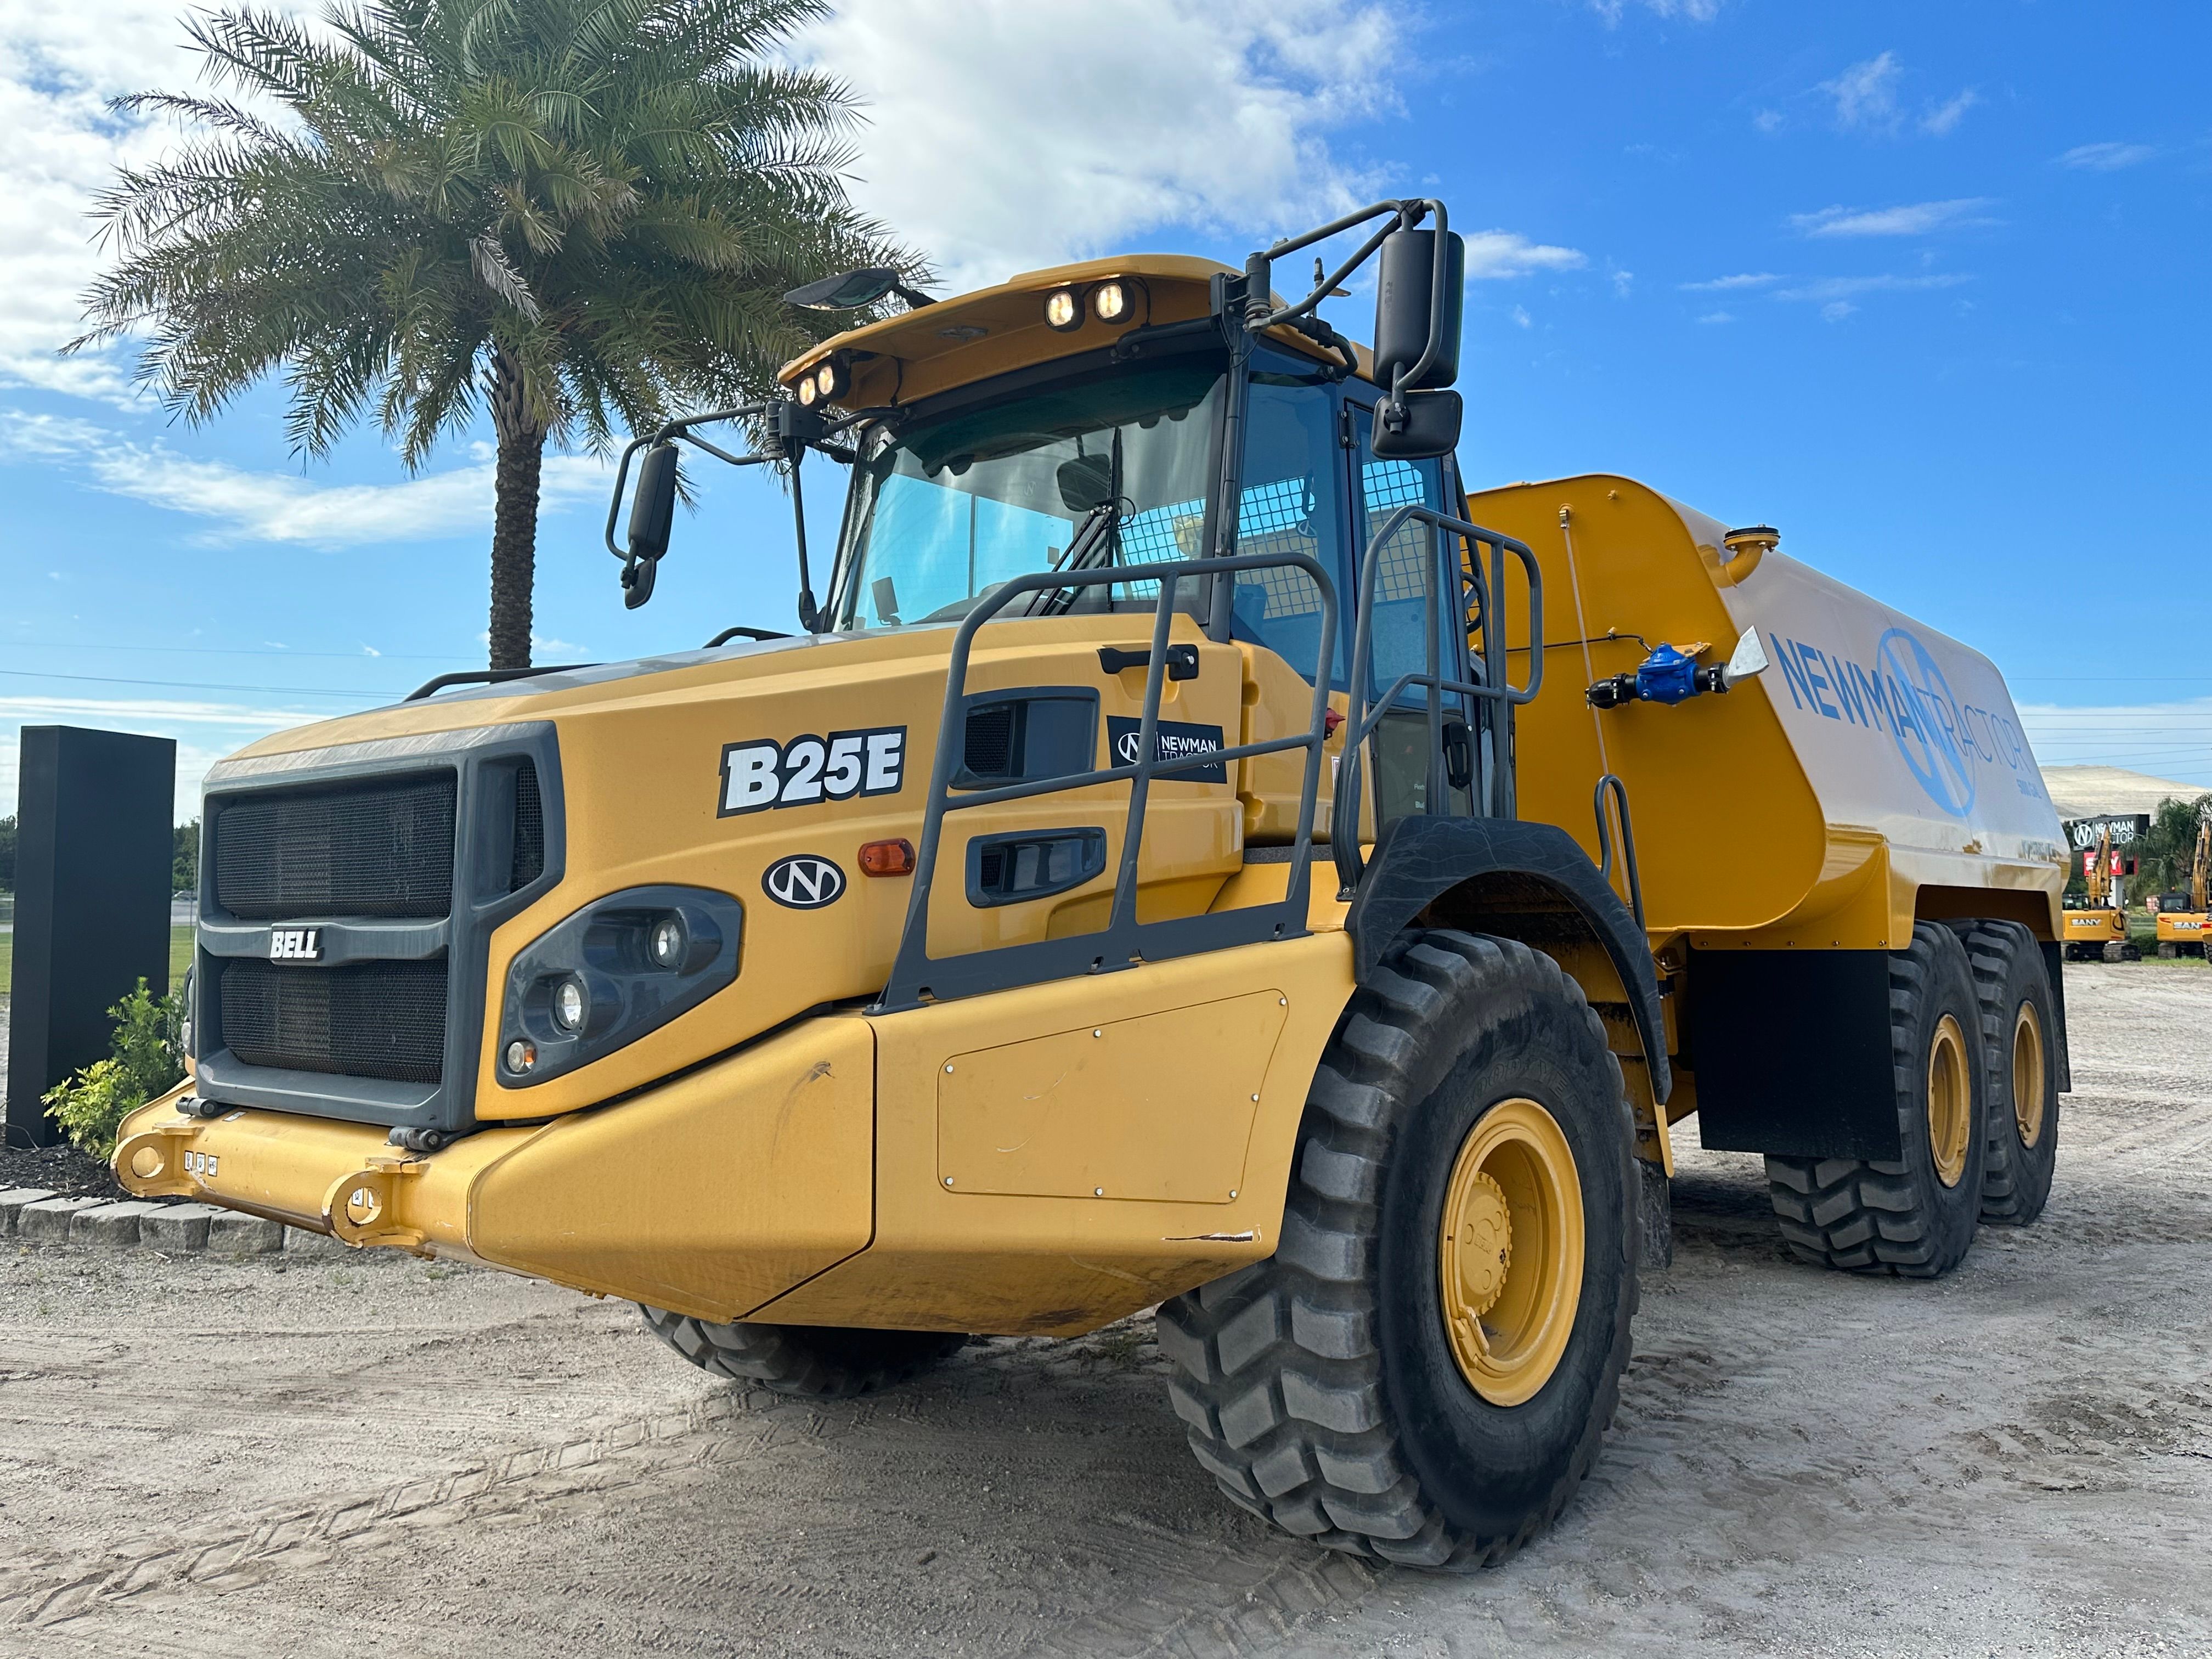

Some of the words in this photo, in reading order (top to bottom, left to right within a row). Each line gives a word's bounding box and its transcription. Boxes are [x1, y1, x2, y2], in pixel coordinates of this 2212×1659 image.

[1769, 633, 1937, 747] NEWMAN
[1917, 685, 2032, 774] TRACTOR
[1161, 736, 1216, 752] NEWMAN
[725, 733, 901, 810] B25E
[2085, 856, 2119, 871] SY
[270, 931, 318, 958] BELL
